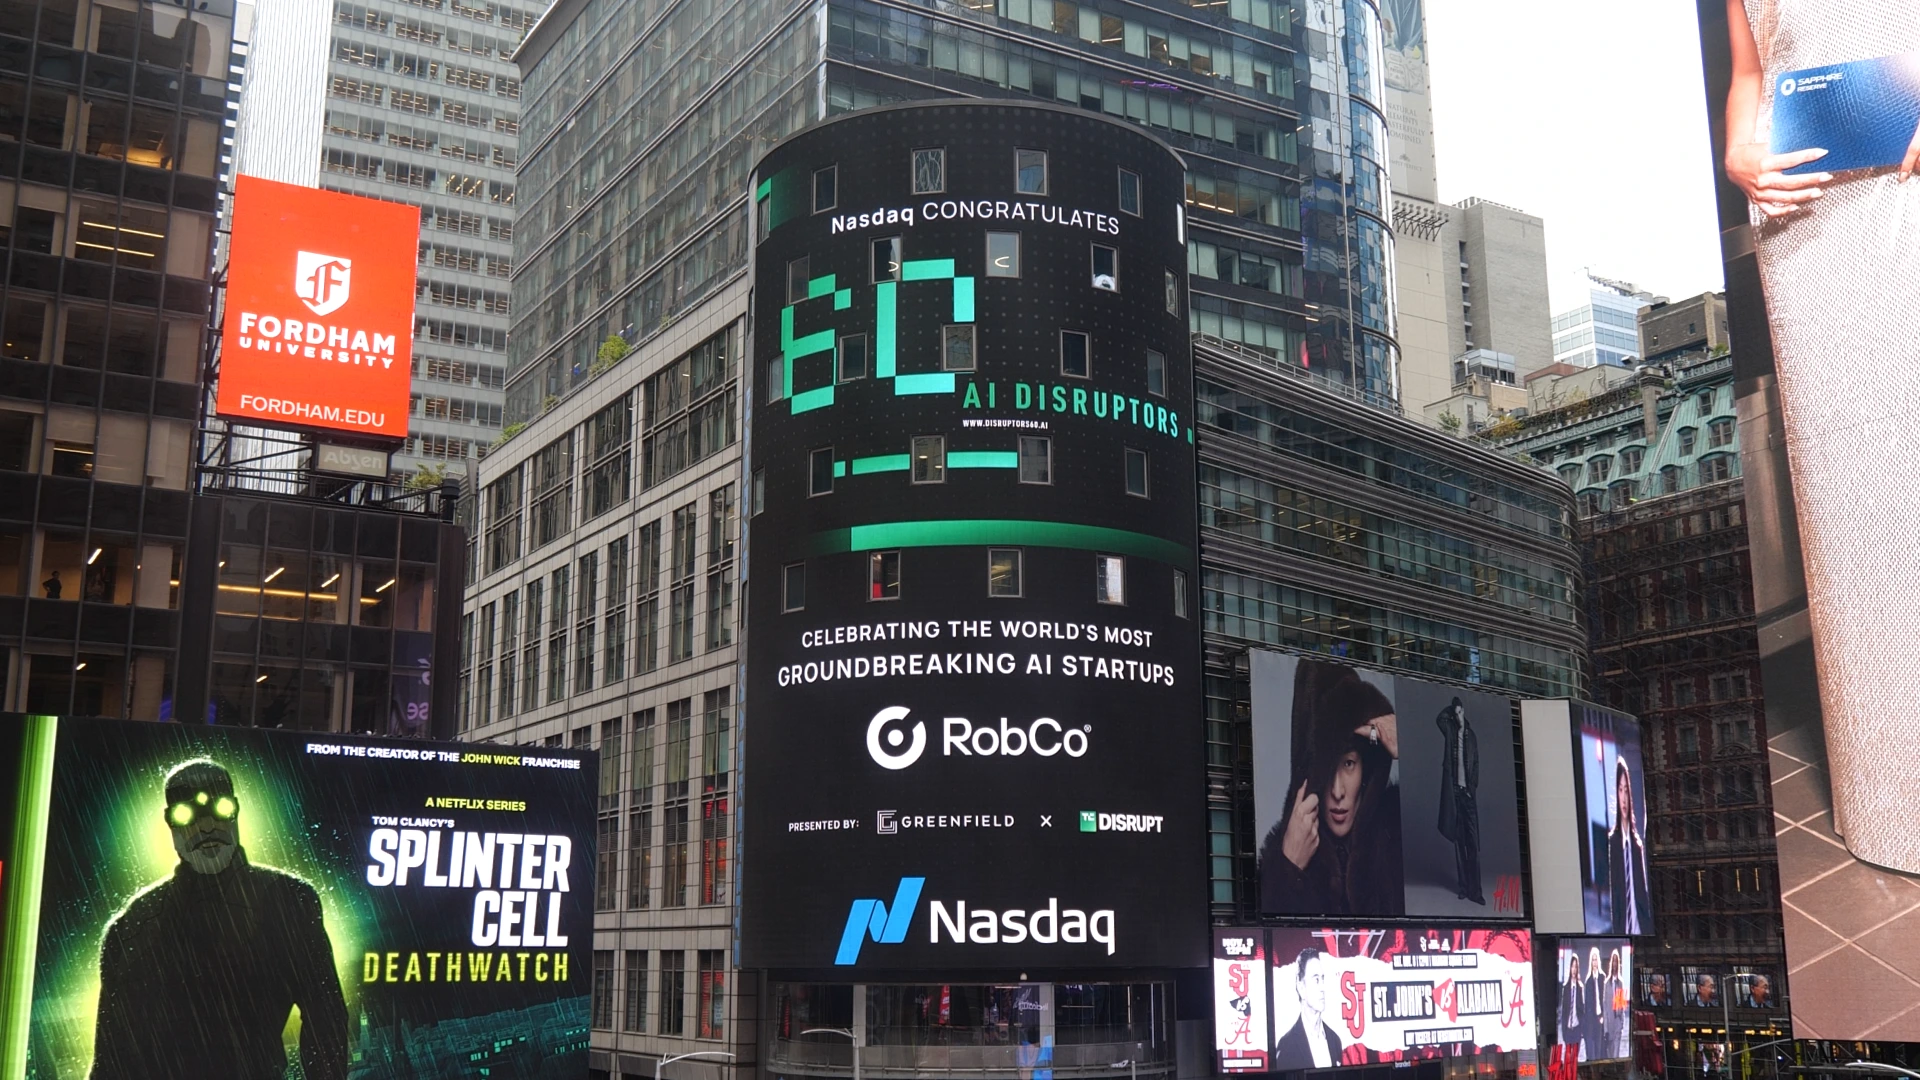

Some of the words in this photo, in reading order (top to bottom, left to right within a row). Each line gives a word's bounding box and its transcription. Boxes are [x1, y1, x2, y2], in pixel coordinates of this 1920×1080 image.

[1797, 72, 1843, 86] SAPPHIRE
[1386, 102, 1417, 117] NATURAL
[1386, 111, 1419, 126] ELEMENTS
[1388, 120, 1426, 137] ASTERFULLY
[1389, 130, 1422, 145] OMBINED.
[831, 206, 914, 235] Nasdaq
[922, 200, 1120, 235] CONGRATULATES
[239, 312, 396, 356] FORDHAM
[239, 336, 395, 370] UNIVERSITY
[240, 394, 386, 428] FORDHAM.EDU
[962, 382, 996, 409] AI
[1015, 382, 1179, 439] DISRUPTORS
[962, 419, 1049, 430] WWW.DISRUPTORS60.AI
[324, 449, 383, 471] Absen
[801, 621, 941, 648] CELEBRATING
[948, 620, 993, 639] THE
[999, 620, 1099, 642] WORLD'S
[1104, 626, 1153, 648] MOST
[777, 652, 1017, 688] GROUNDBREAKING
[1025, 653, 1052, 676] AI
[1062, 654, 1175, 687] STARTUPS
[306, 743, 341, 756] FROM
[342, 745, 366, 757] THE
[367, 747, 419, 760] CREATOR
[420, 750, 437, 761] OF
[438, 751, 460, 763] THE
[461, 754, 492, 765] JOHN
[493, 755, 521, 767] WICK
[522, 756, 581, 770] FRANCHISE
[425, 797, 434, 808] A
[436, 797, 485, 810] NETFLIX
[486, 799, 526, 812] SERIES
[372, 816, 399, 826] TOM
[400, 816, 455, 829] CLANCY'S
[788, 819, 841, 833] PRESENTED
[843, 818, 860, 830] BY:
[901, 815, 1015, 829] GREENFIELD
[1099, 812, 1164, 833] DISRUPT
[366, 828, 573, 893] SPLINTER
[1493, 874, 1520, 913] H&M
[471, 890, 569, 947] CELL
[930, 897, 1116, 957] Nasdaq
[363, 952, 569, 983] DEATHWATCH
[1340, 970, 1367, 1039] SJ
[1373, 985, 1392, 1019] ST.
[1394, 983, 1434, 1018] JOHN'S
[1457, 982, 1503, 1014] ALABAMA
